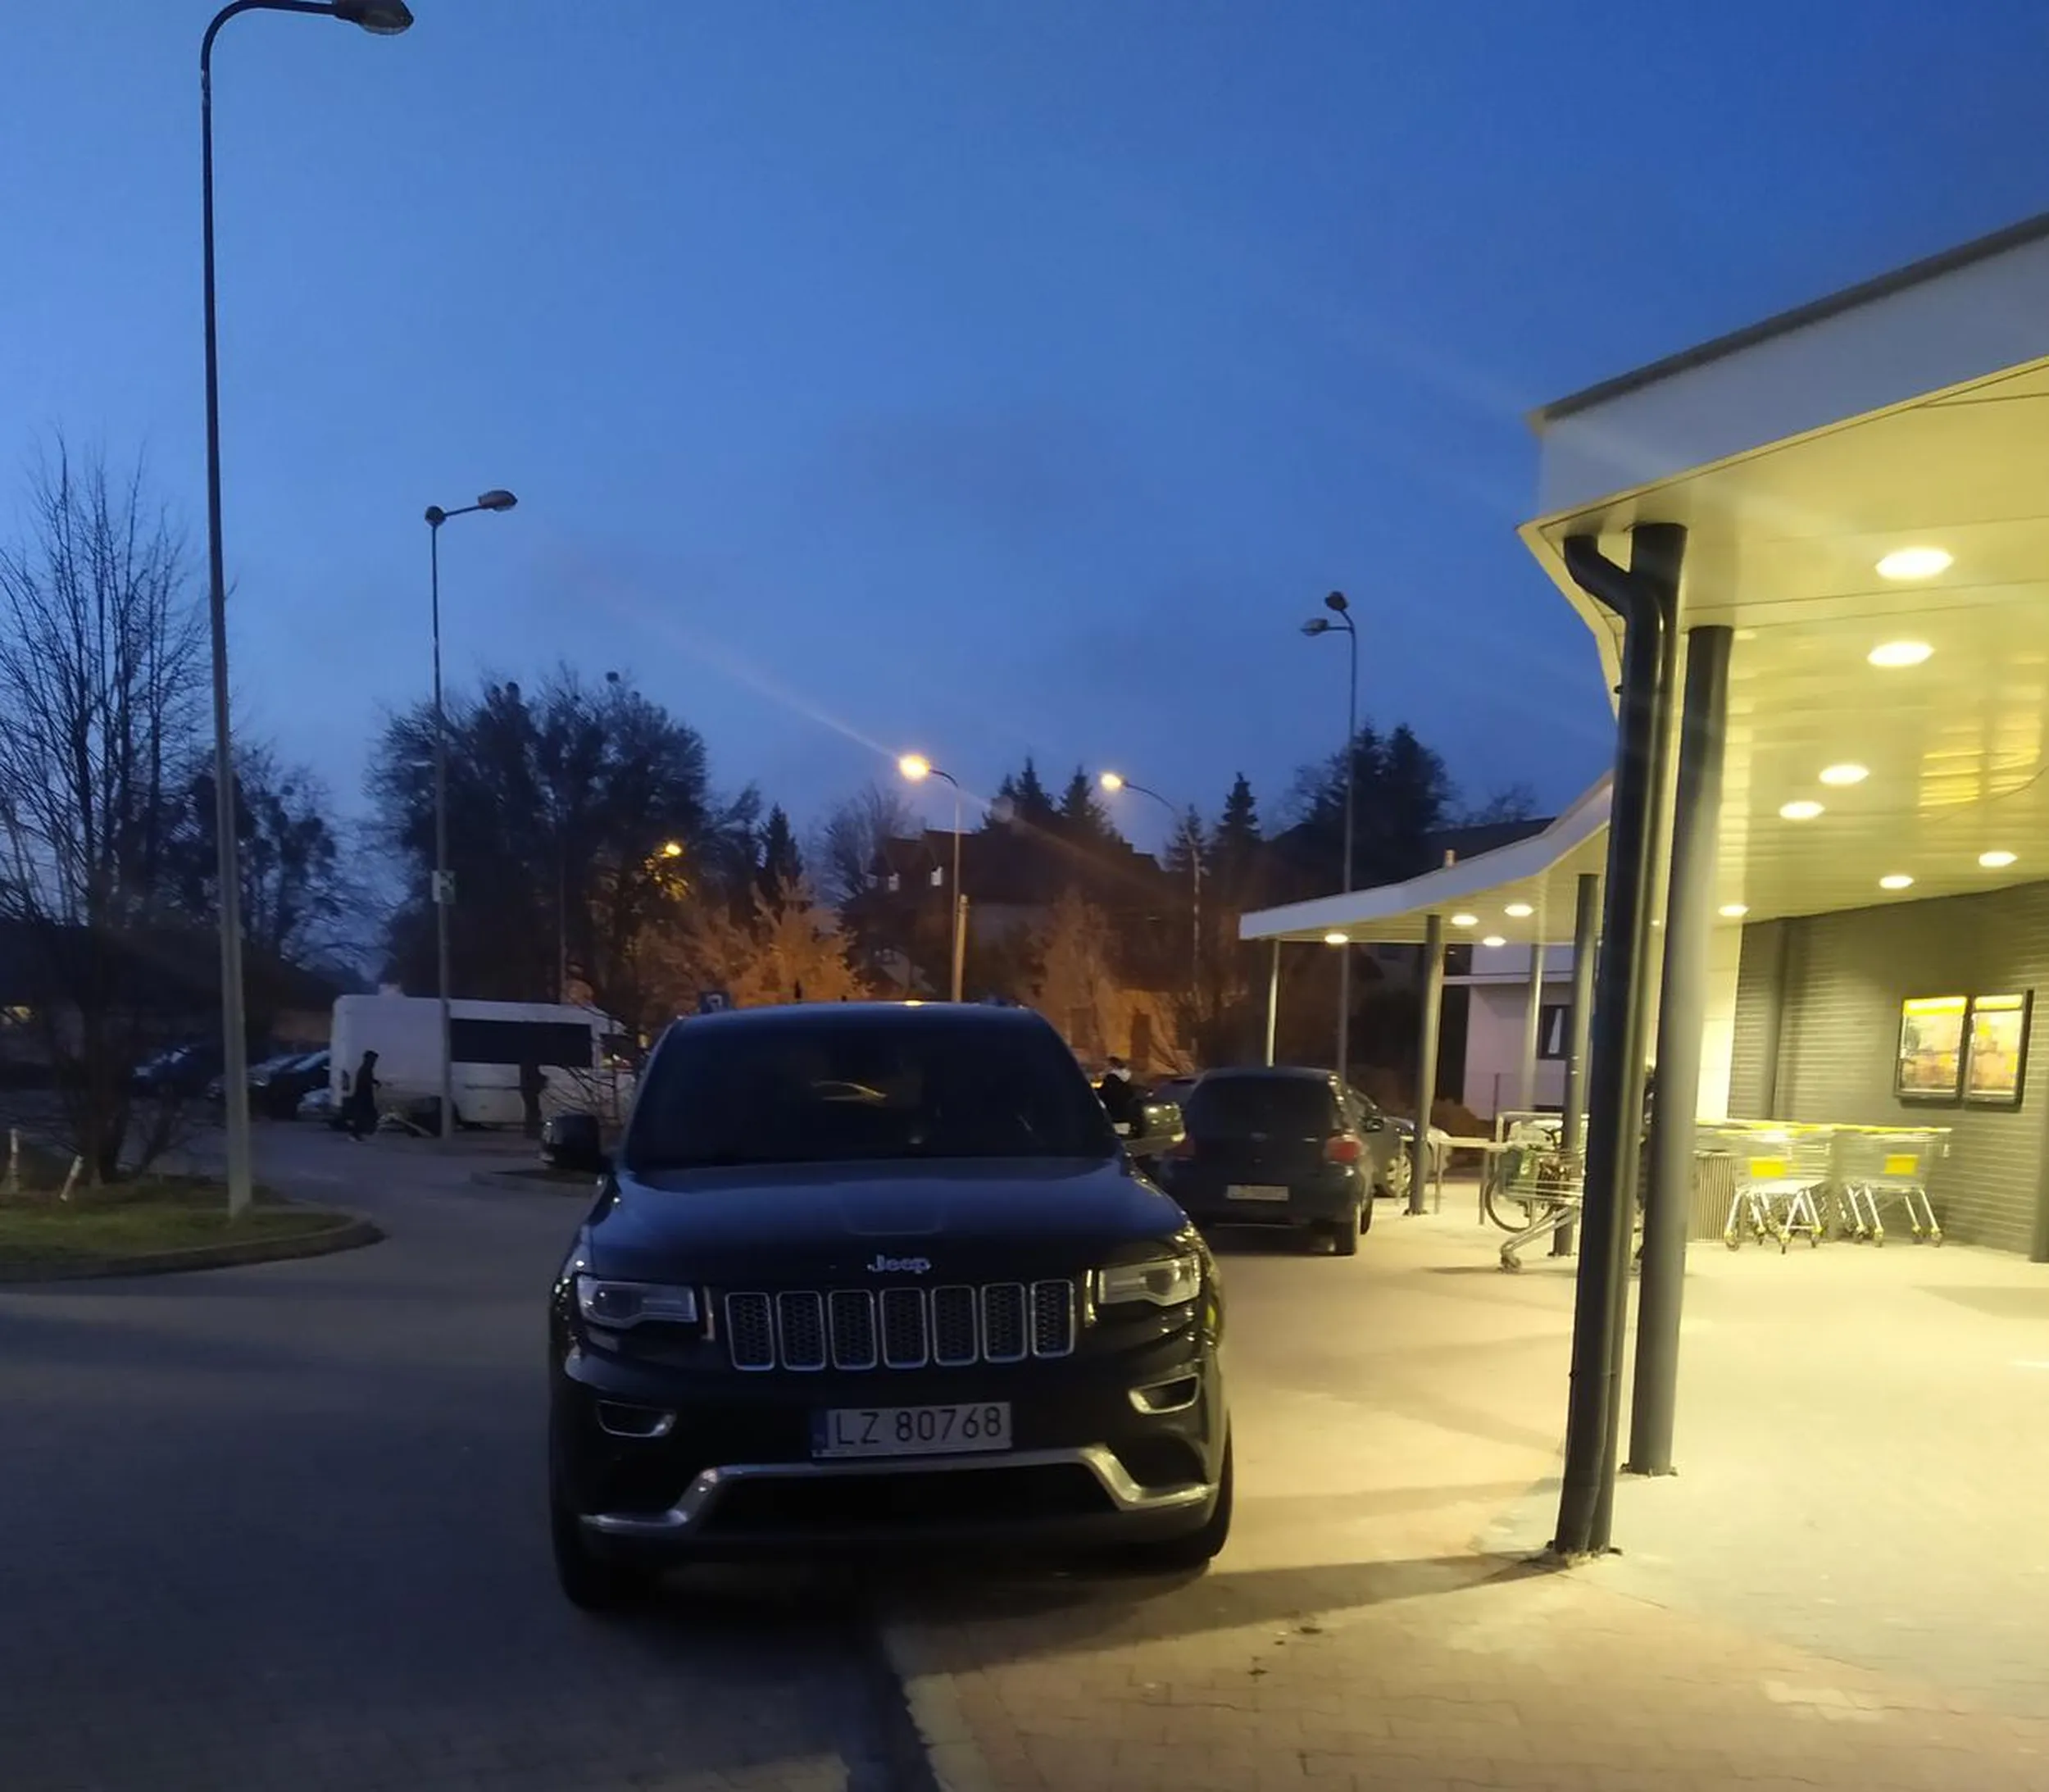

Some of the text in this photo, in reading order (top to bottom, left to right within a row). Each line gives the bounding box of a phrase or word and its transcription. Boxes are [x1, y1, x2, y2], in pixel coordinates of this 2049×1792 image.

[867, 1254, 931, 1274] Jeep
[836, 1406, 1002, 1445] LZ 80768
